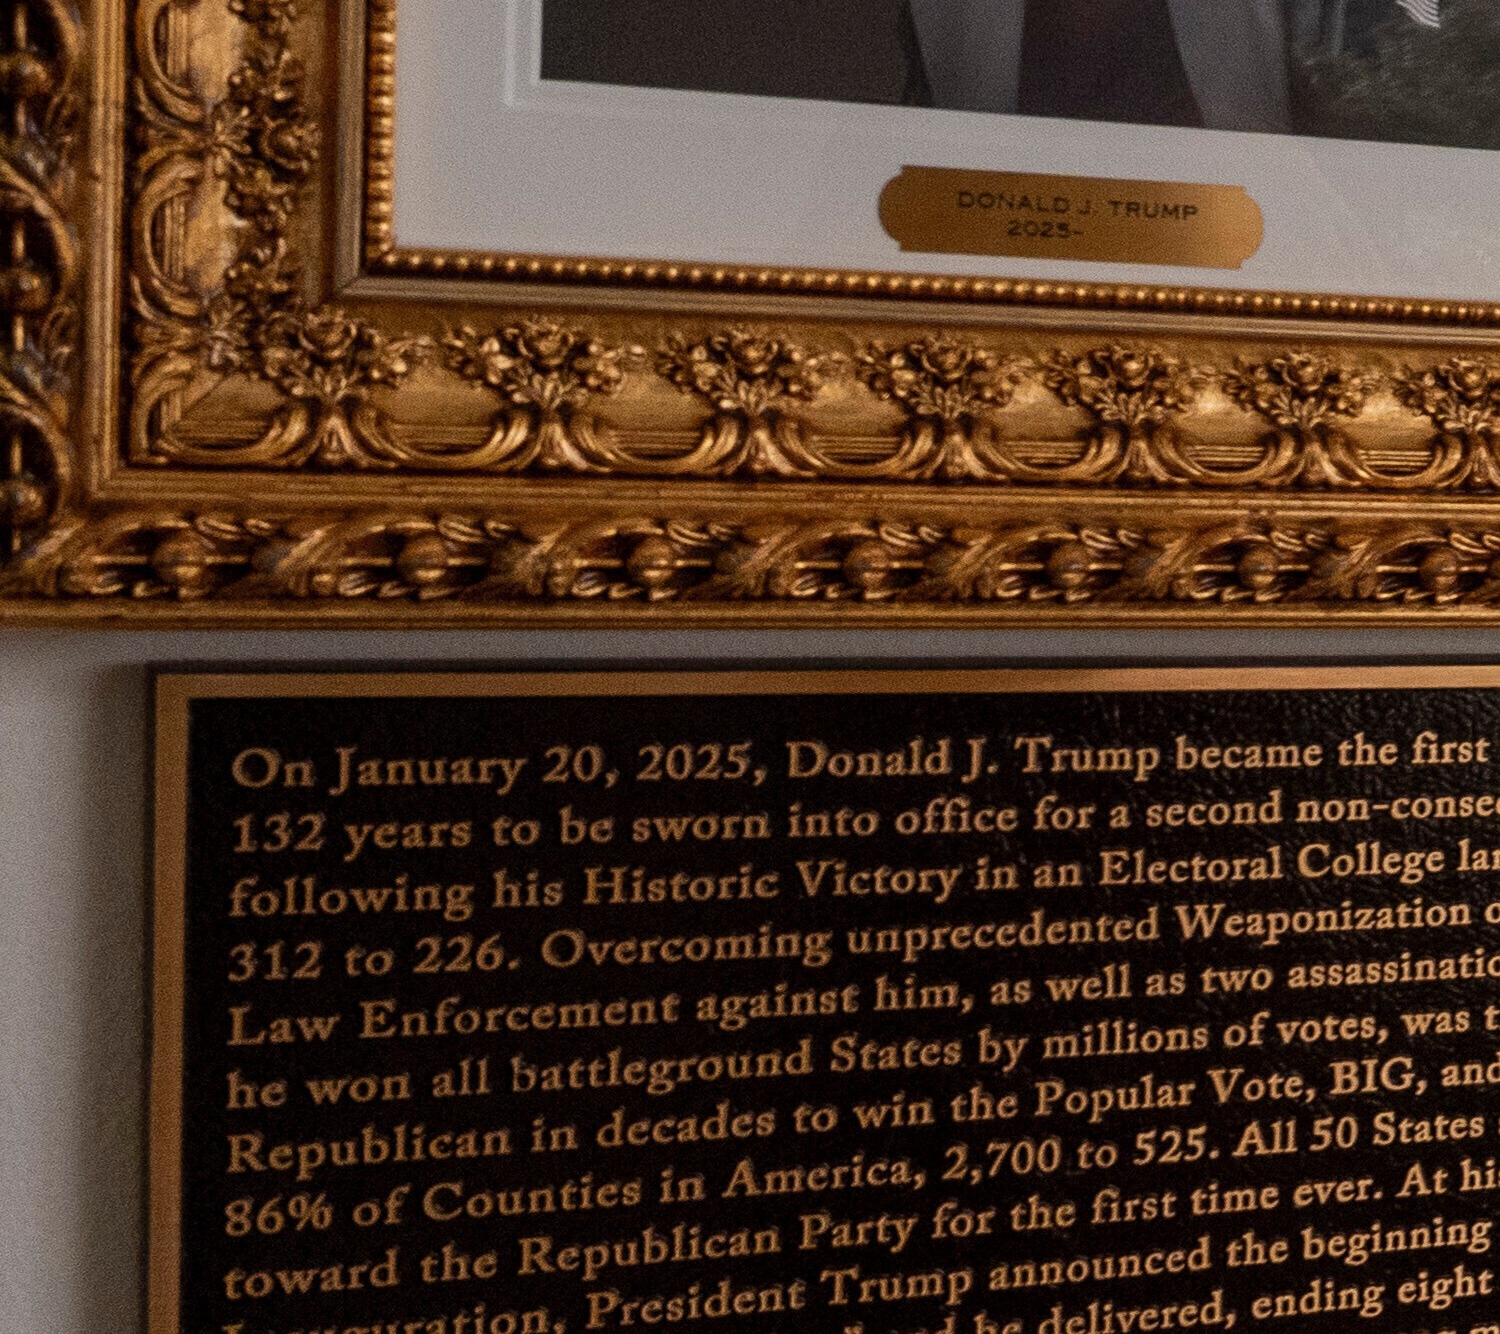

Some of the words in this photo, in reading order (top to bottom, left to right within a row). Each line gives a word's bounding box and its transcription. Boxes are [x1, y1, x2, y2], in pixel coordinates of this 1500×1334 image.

[957, 191, 1070, 213] DONALD
[1079, 201, 1097, 216] J.
[1111, 200, 1198, 220] TRUMP
[232, 748, 312, 787] On
[330, 748, 526, 795] January
[544, 746, 616, 787] 20,
[638, 742, 766, 785] 2025,
[787, 738, 951, 777] Donald
[961, 737, 997, 783] J.
[1014, 735, 1160, 782] Trump
[1175, 734, 1322, 770] became
[1338, 731, 1398, 767] the
[1411, 730, 1490, 765] first
